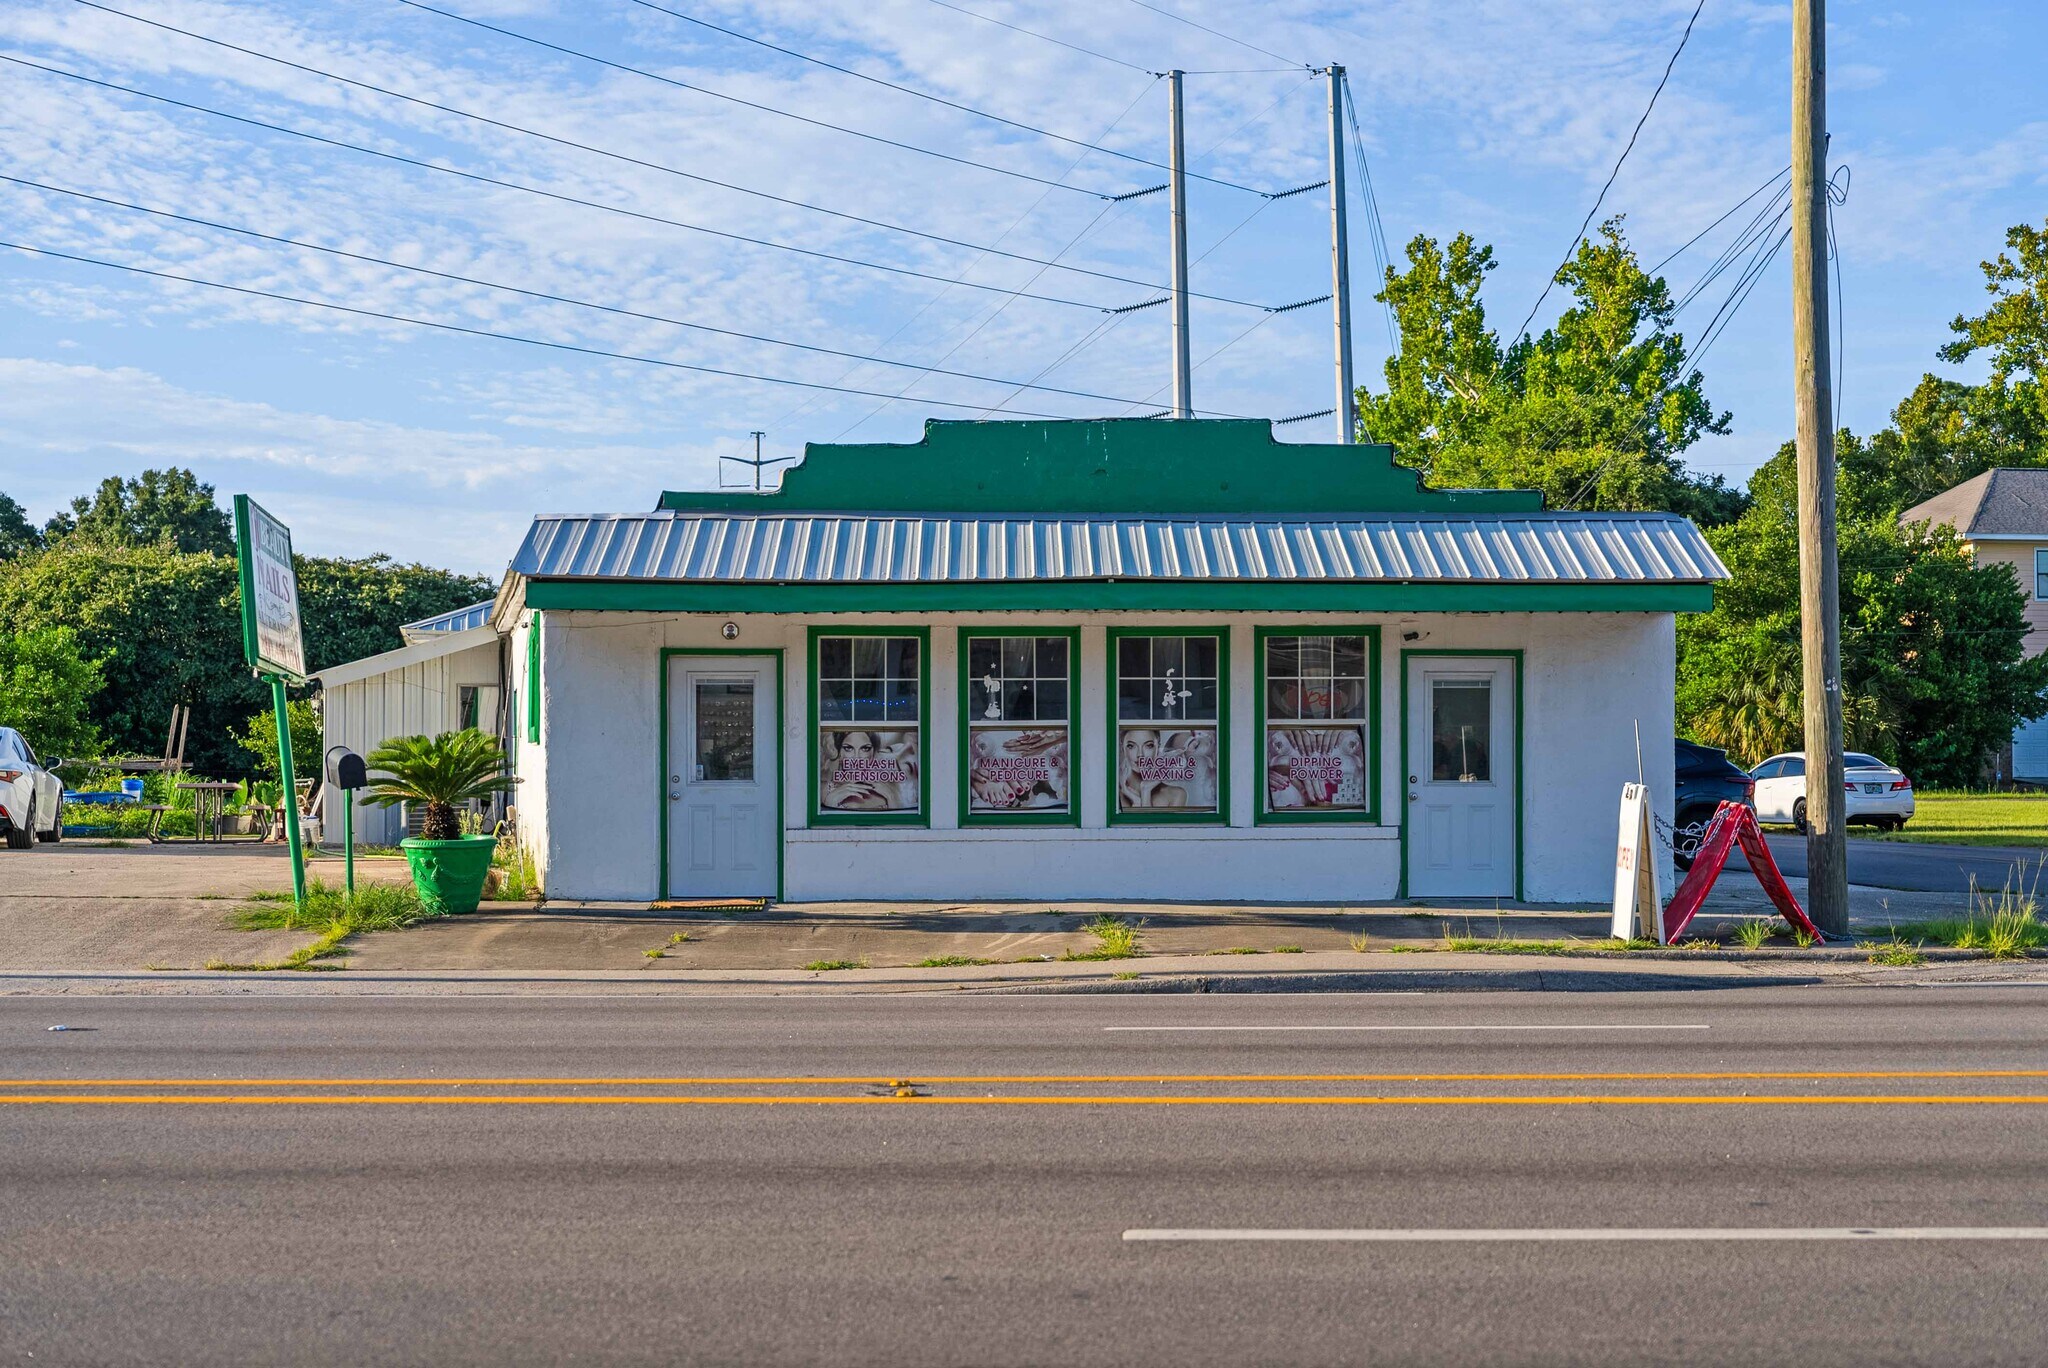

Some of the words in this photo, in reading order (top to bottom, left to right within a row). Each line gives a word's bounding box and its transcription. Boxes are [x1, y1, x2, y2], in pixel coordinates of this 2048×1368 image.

[256, 554, 291, 604] NAILS
[843, 759, 896, 770] EYELASH
[980, 757, 1046, 769] MANICURE
[1050, 757, 1060, 769] &
[1139, 757, 1185, 768] FACIAL
[1187, 757, 1197, 768] &
[1291, 757, 1342, 767] DIPPING
[834, 771, 907, 782] EXTENSIONS
[990, 769, 1049, 780] PEDICURE
[1141, 769, 1195, 780] WAXING
[1290, 769, 1344, 780] POWDER
